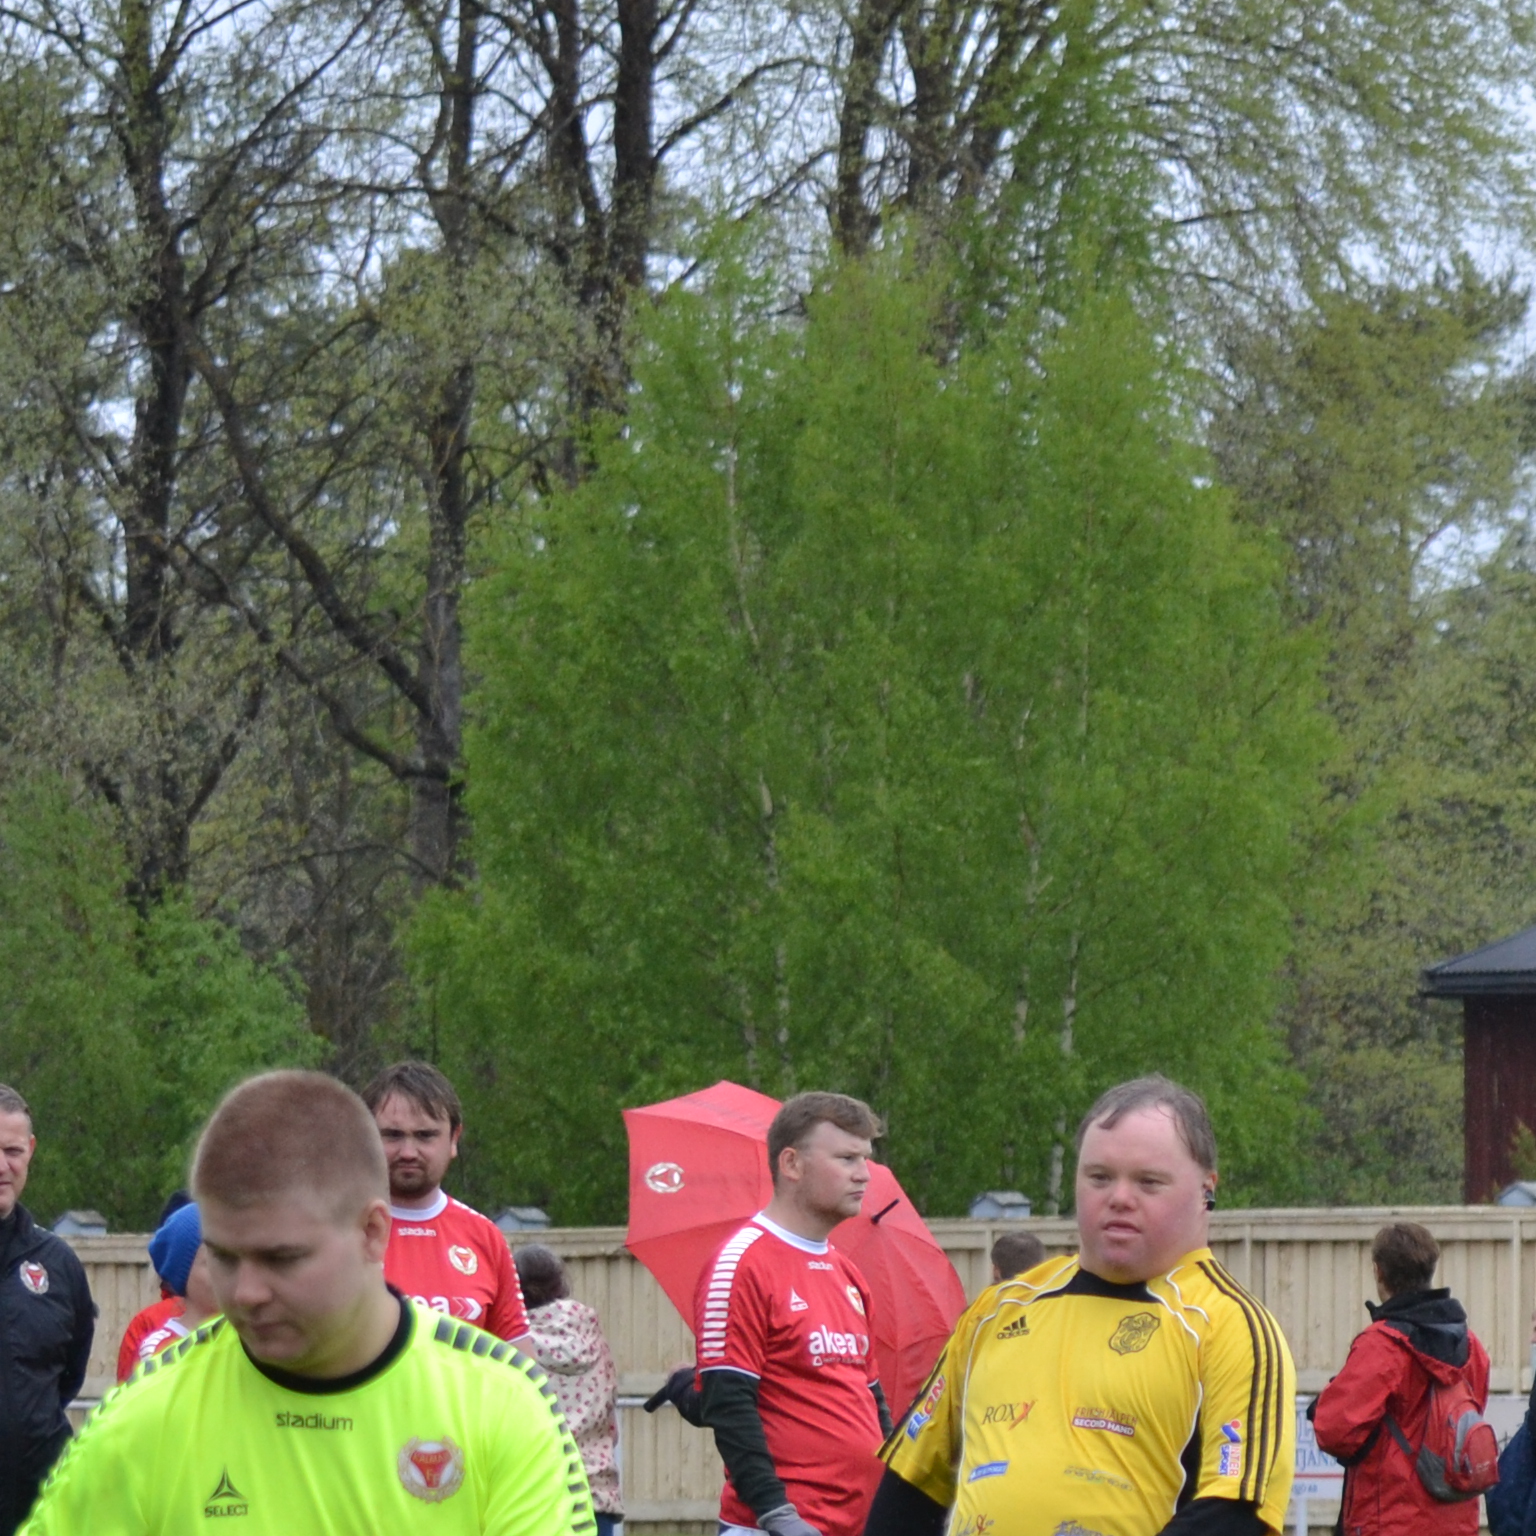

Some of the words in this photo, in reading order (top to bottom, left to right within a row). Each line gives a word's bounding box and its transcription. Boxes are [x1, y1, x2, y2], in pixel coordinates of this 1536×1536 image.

[809, 1324, 858, 1355] akea
[906, 1376, 946, 1441] ELON
[276, 1411, 353, 1431] stadium
[1074, 1417, 1106, 1428] SECOND
[1108, 1422, 1135, 1436] HAND
[204, 1504, 249, 1518] SELECT
